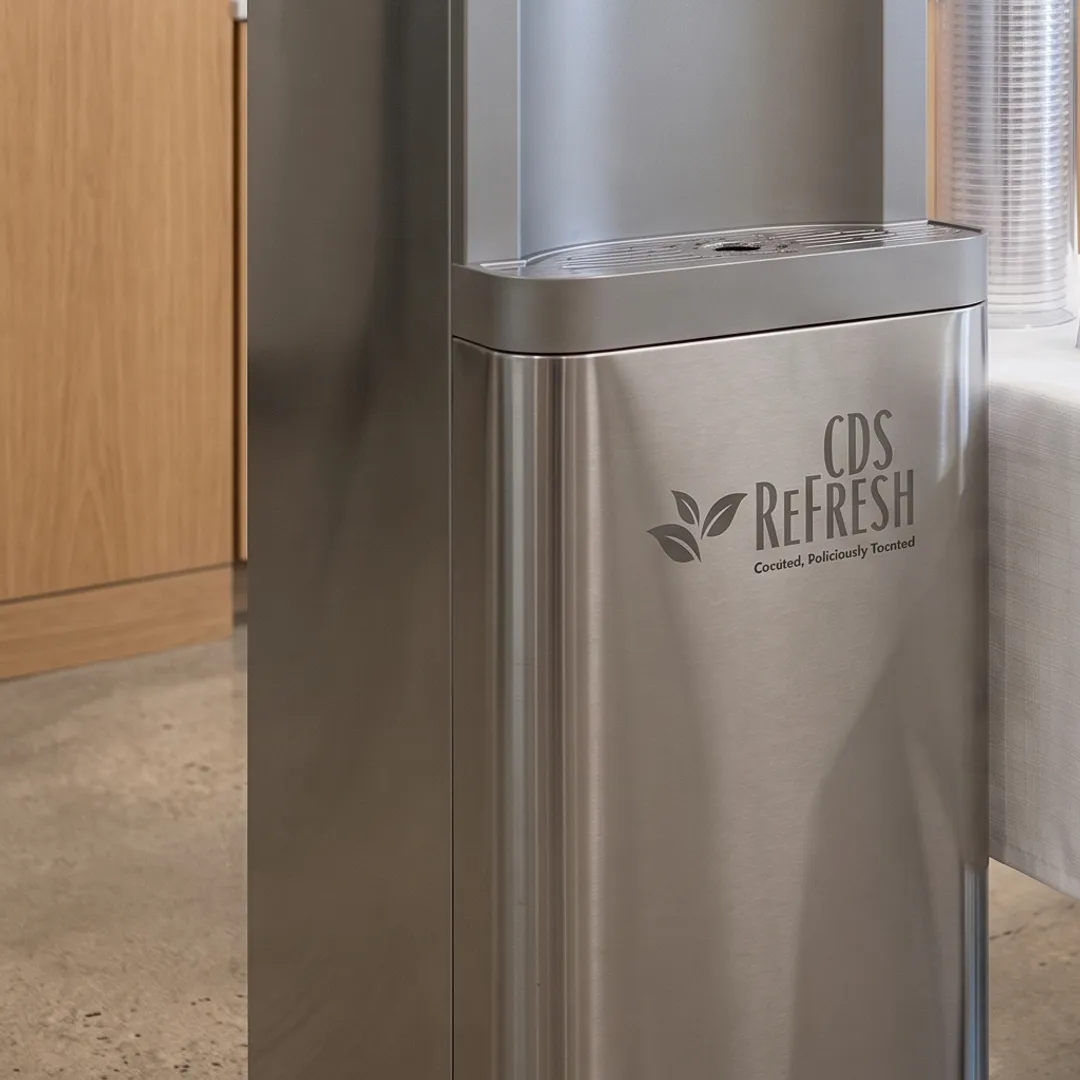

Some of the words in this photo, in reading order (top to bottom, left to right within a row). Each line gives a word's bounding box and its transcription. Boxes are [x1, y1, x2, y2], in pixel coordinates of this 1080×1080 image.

[823, 409, 893, 478] CDS
[808, 545, 868, 565] Policiously
[871, 535, 915, 554] Tocnted
